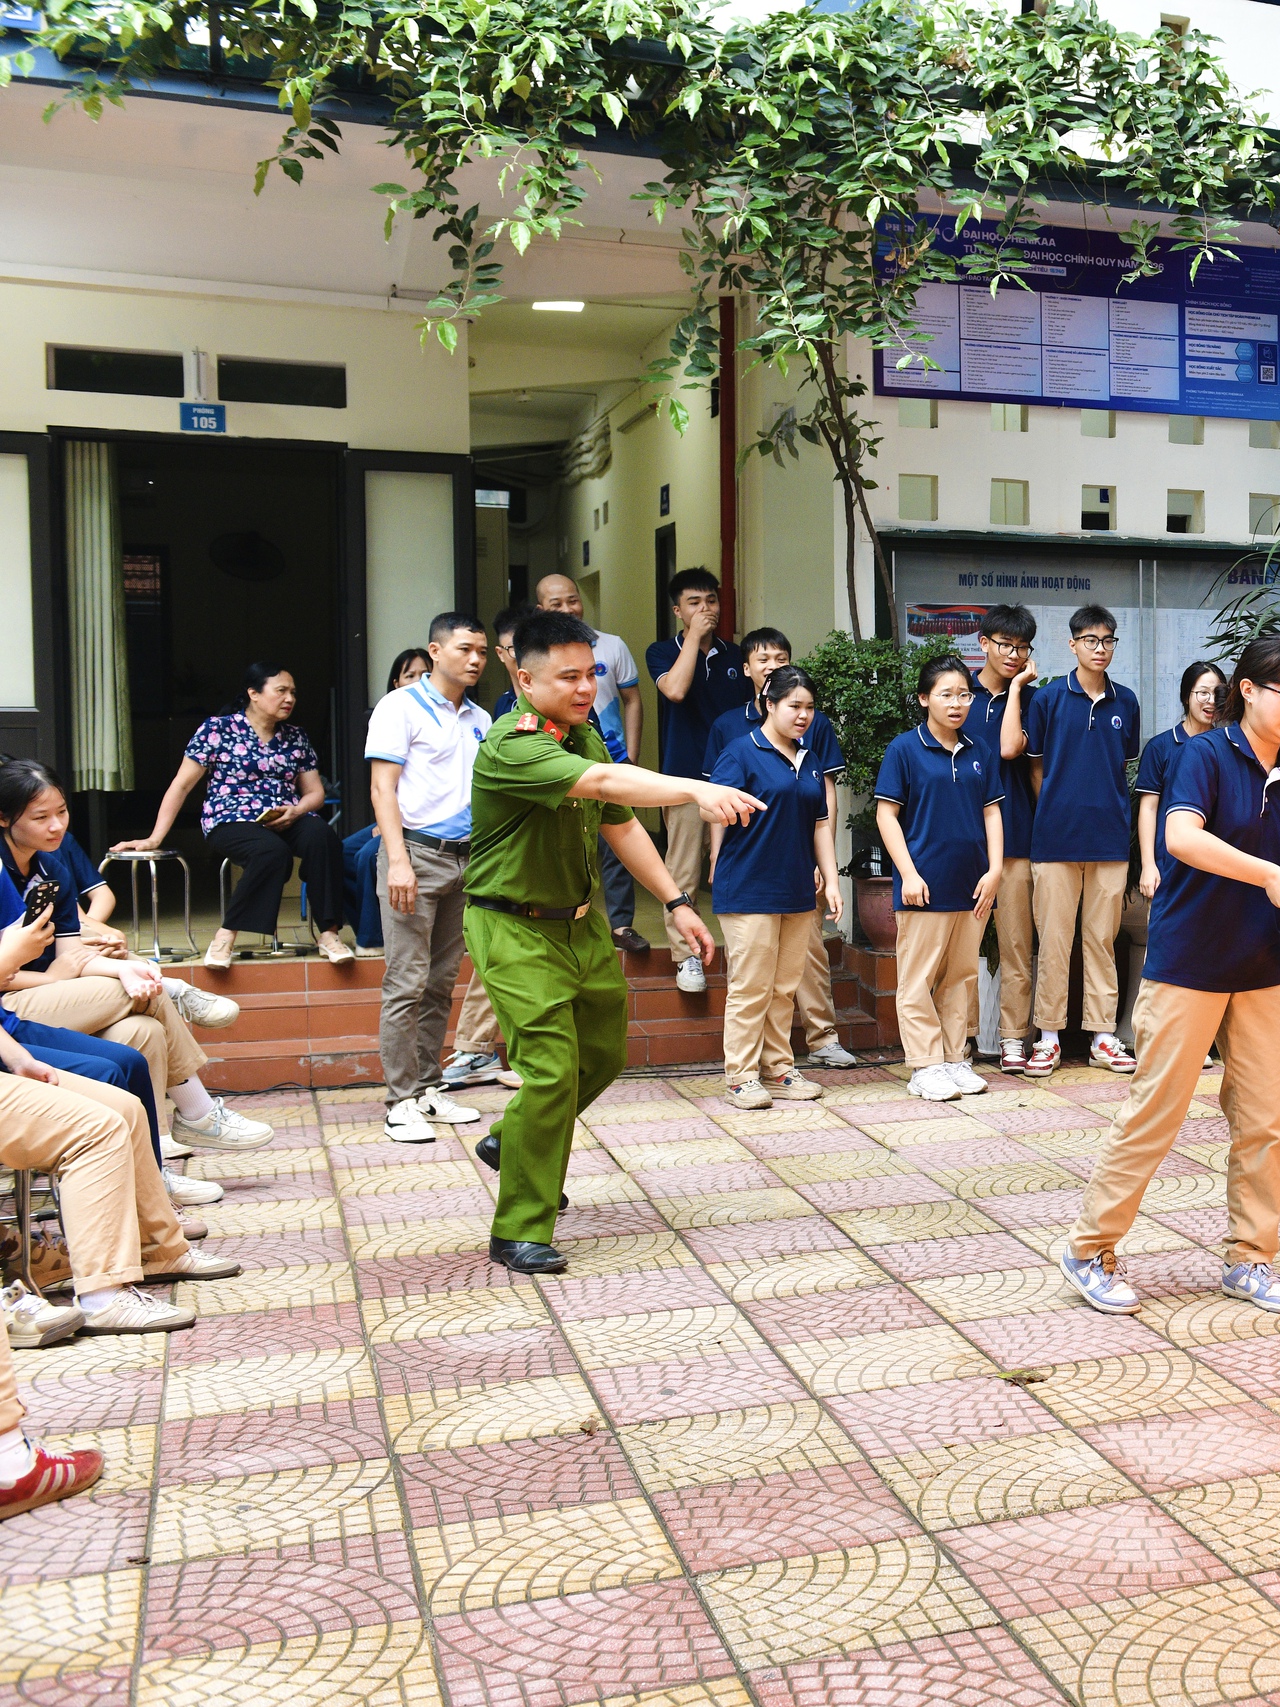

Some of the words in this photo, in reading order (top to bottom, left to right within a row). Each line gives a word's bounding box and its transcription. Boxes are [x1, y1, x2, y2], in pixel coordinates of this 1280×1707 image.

[962, 229, 981, 242] ĐẠI
[1024, 250, 1040, 262] ĐẠI
[1042, 252, 1062, 264] HỌC
[1064, 252, 1094, 266] CHÍNH
[1095, 256, 1114, 267] QUY
[192, 416, 217, 429] 105
[958, 572, 978, 589] MỘT
[981, 570, 993, 587] SỐ
[996, 572, 1017, 588] HÌNH
[1020, 570, 1039, 589] ẢNH
[1041, 576, 1064, 592] HOẠT
[1066, 574, 1091, 592] ĐỘNG
